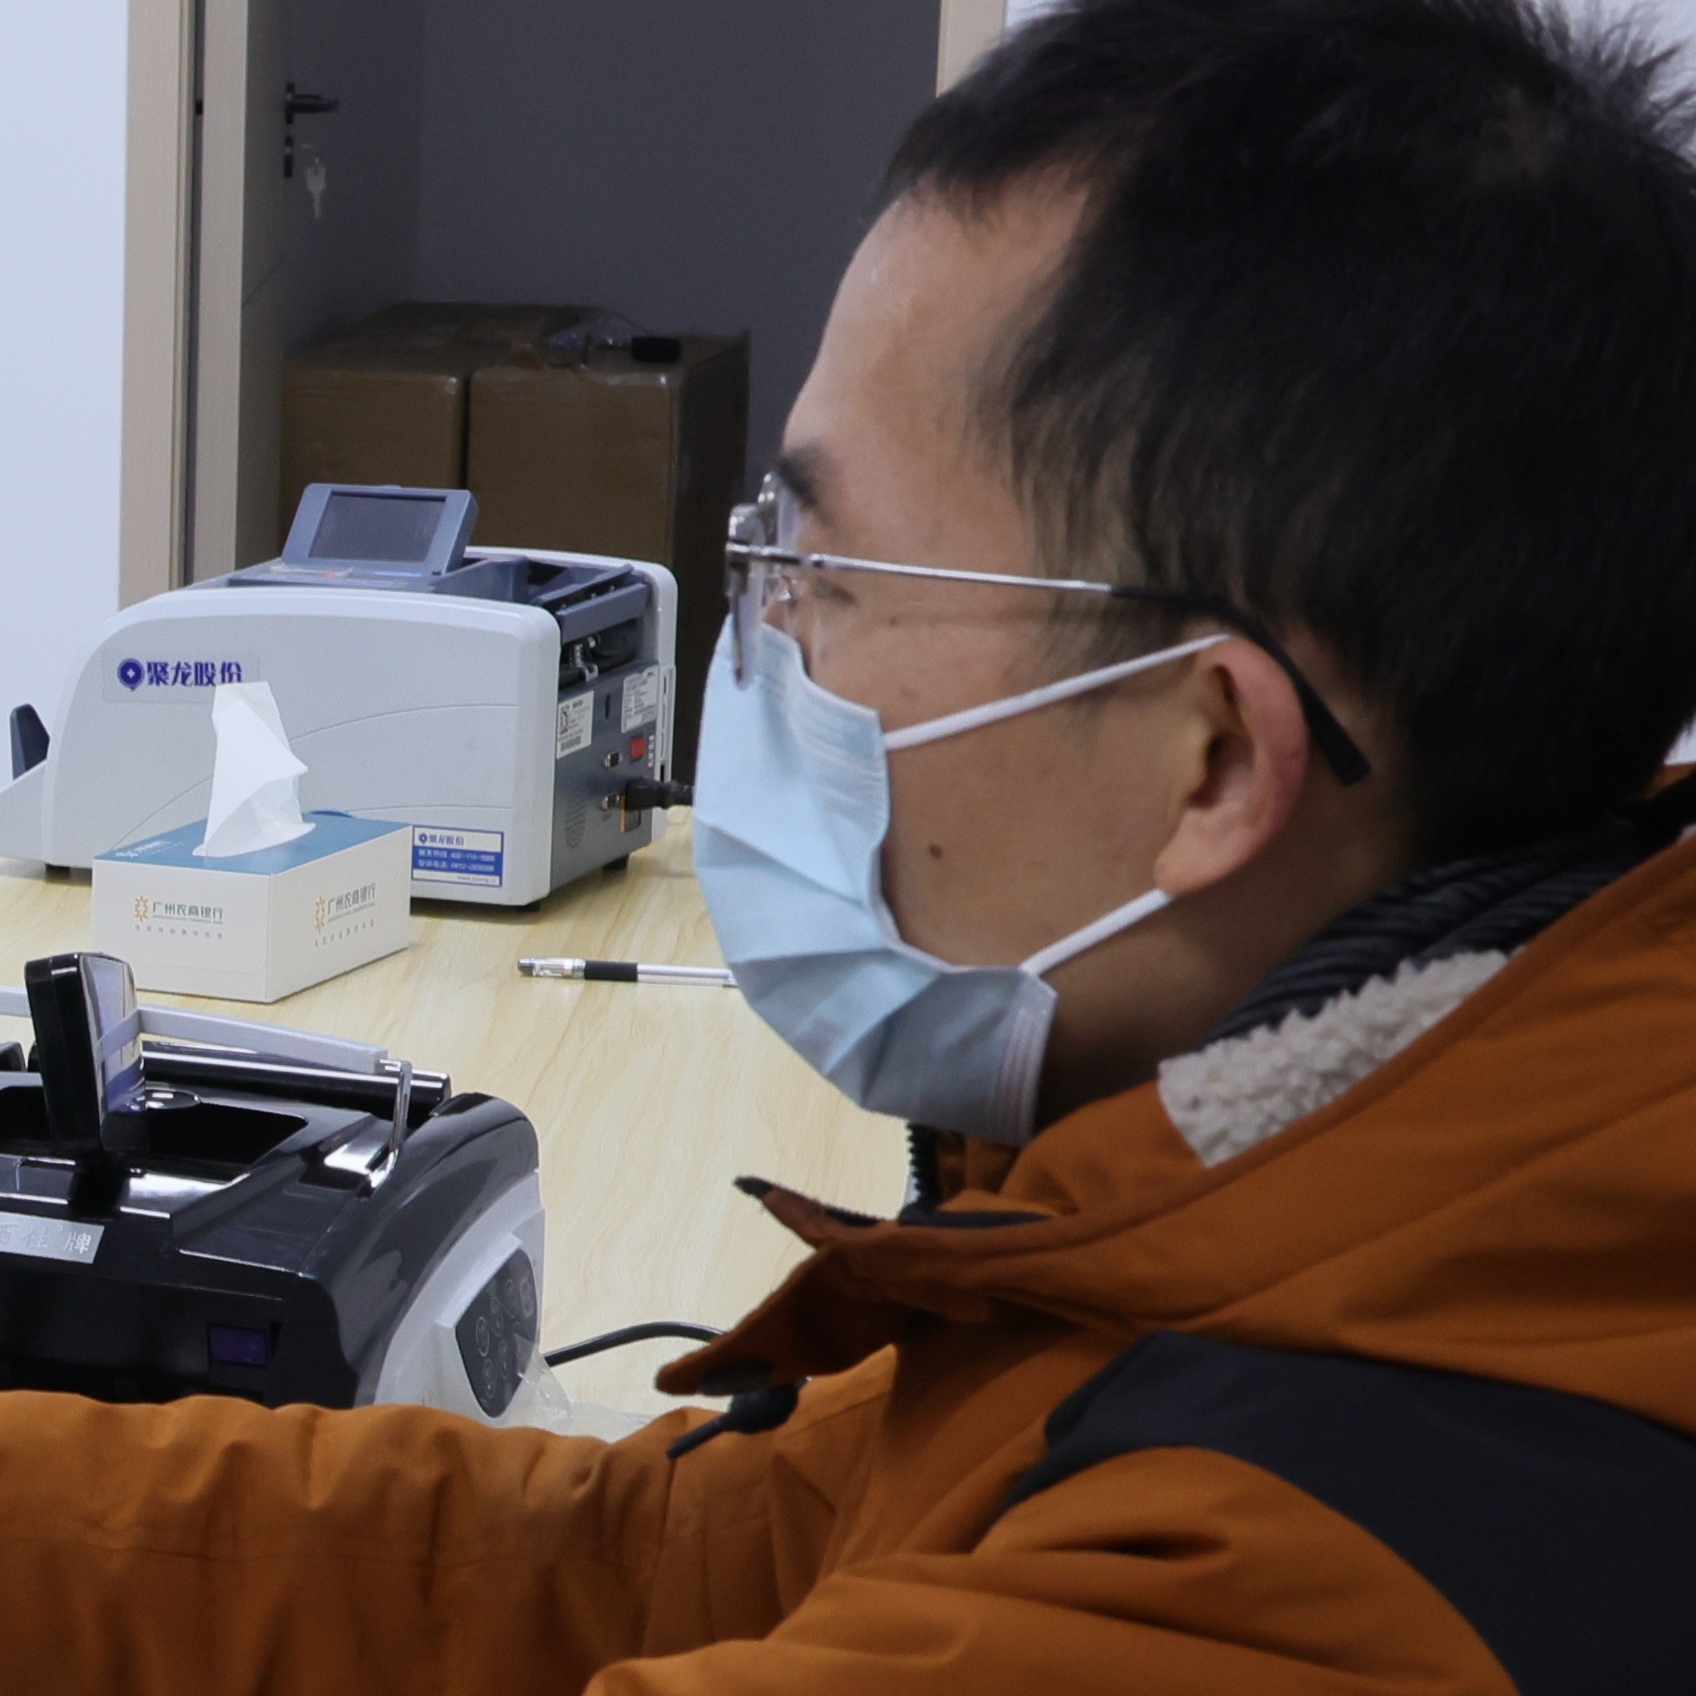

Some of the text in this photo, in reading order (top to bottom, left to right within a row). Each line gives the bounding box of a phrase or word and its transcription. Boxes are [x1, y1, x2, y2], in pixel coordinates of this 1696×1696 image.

[146, 660, 243, 687] 聚龙股份
[152, 901, 224, 920] 广州农商银行
